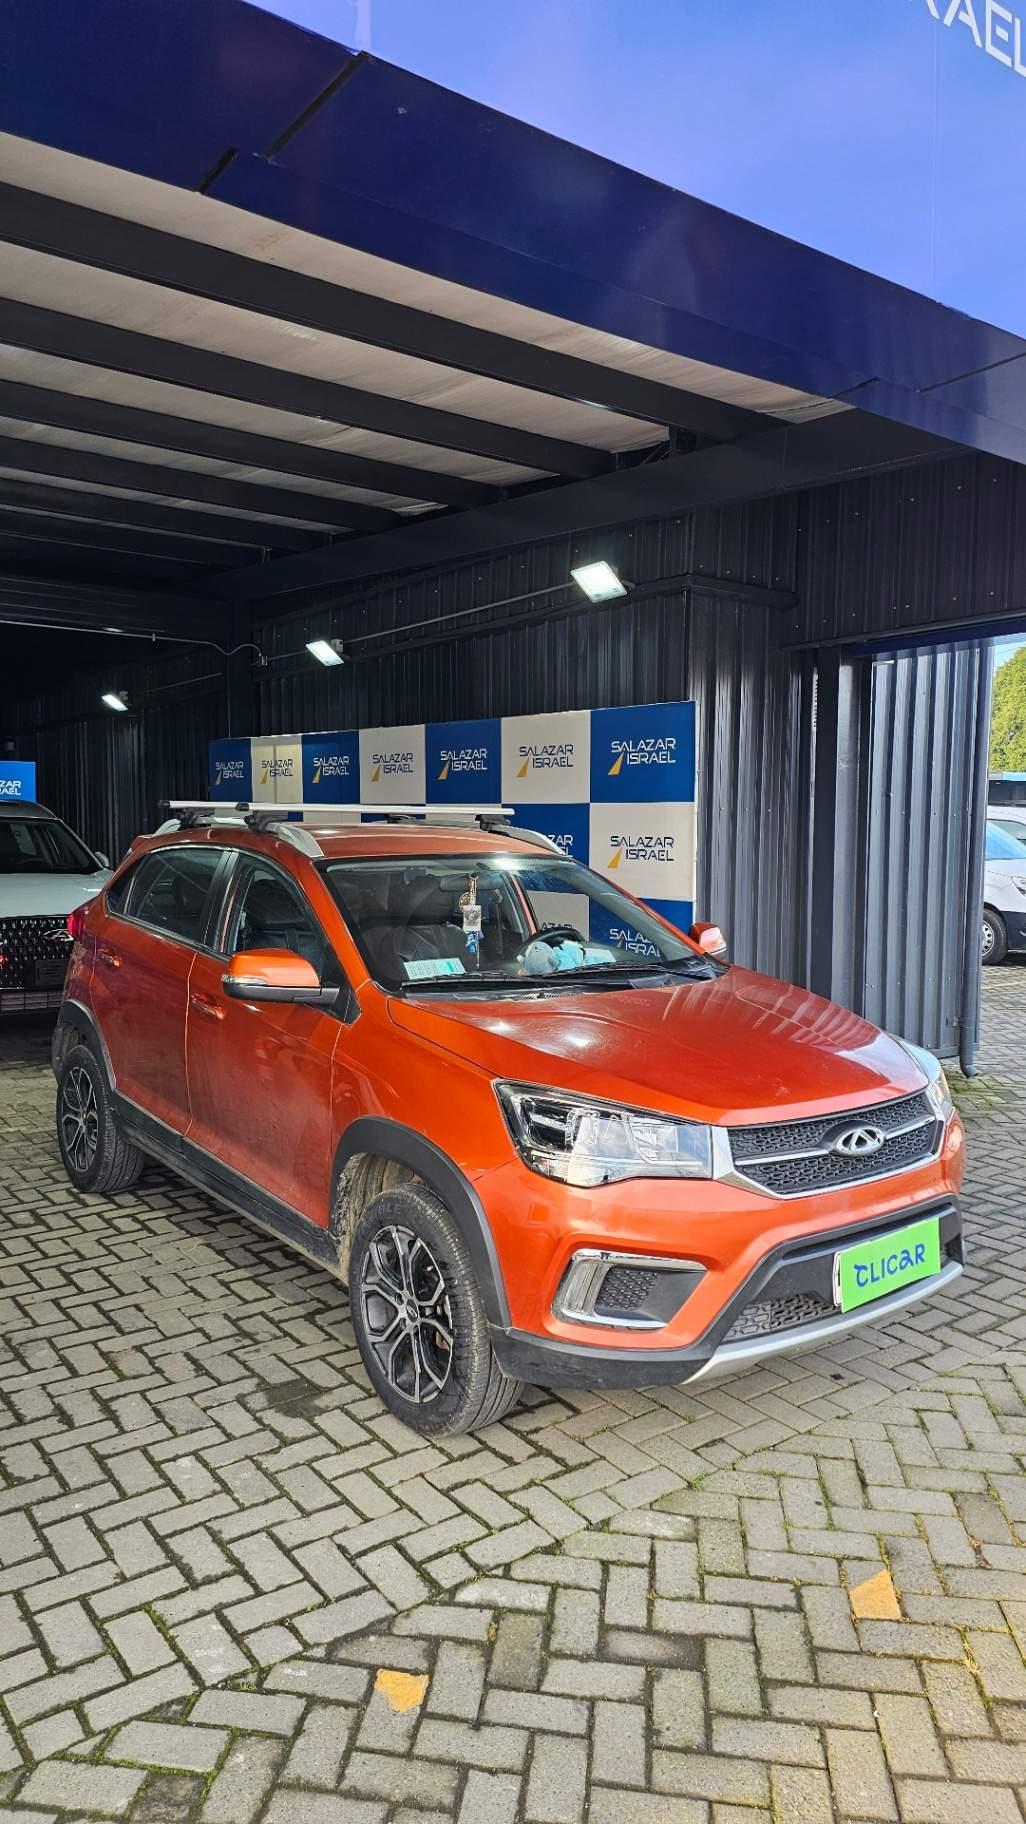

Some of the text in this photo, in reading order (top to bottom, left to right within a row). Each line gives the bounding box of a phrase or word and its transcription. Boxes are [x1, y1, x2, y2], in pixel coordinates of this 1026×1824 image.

[519, 744, 574, 757] SALAZAR
[611, 737, 676, 753] SALAZAR
[372, 752, 414, 763] SALAZAR
[440, 748, 488, 761] SALAZAR
[626, 751, 676, 765] ISRAEL
[215, 761, 244, 771] SALAZAR
[261, 759, 294, 769] SALAZAR
[313, 756, 350, 767] SALAZAR
[451, 760, 488, 771] ISRAEL
[532, 756, 574, 768] ISRAEL
[322, 766, 350, 776] ISRAEL
[383, 763, 414, 773] ISRAEL
[610, 835, 675, 848] SALAZAR
[625, 848, 675, 861] ISRAEL
